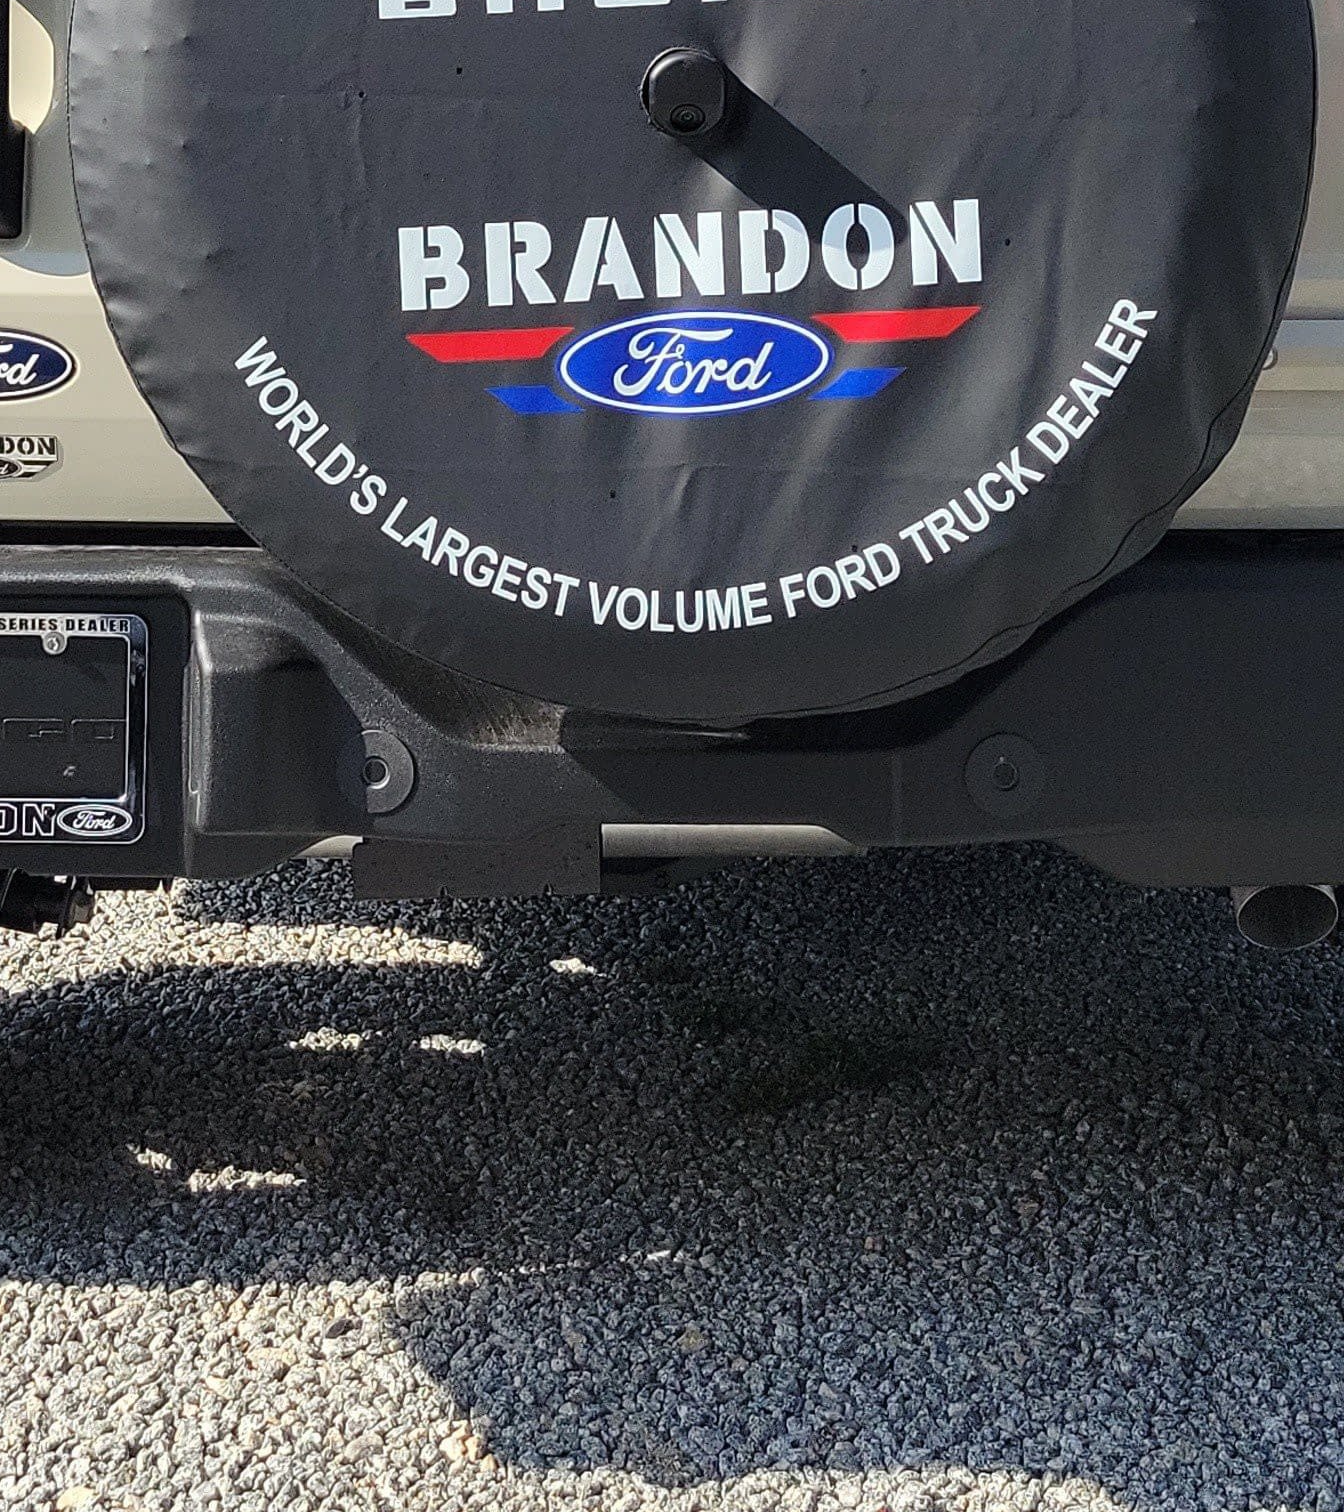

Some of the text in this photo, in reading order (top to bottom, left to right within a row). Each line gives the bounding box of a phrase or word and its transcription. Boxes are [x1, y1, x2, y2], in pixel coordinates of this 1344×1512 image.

[398, 198, 983, 311] BRANDON
[612, 328, 774, 396] Ford
[234, 297, 1159, 634] WORLD'S LARGEST VOLUME FORD TRUCK DEALER
[66, 618, 131, 633] DEALER
[73, 809, 116, 830] Ford
